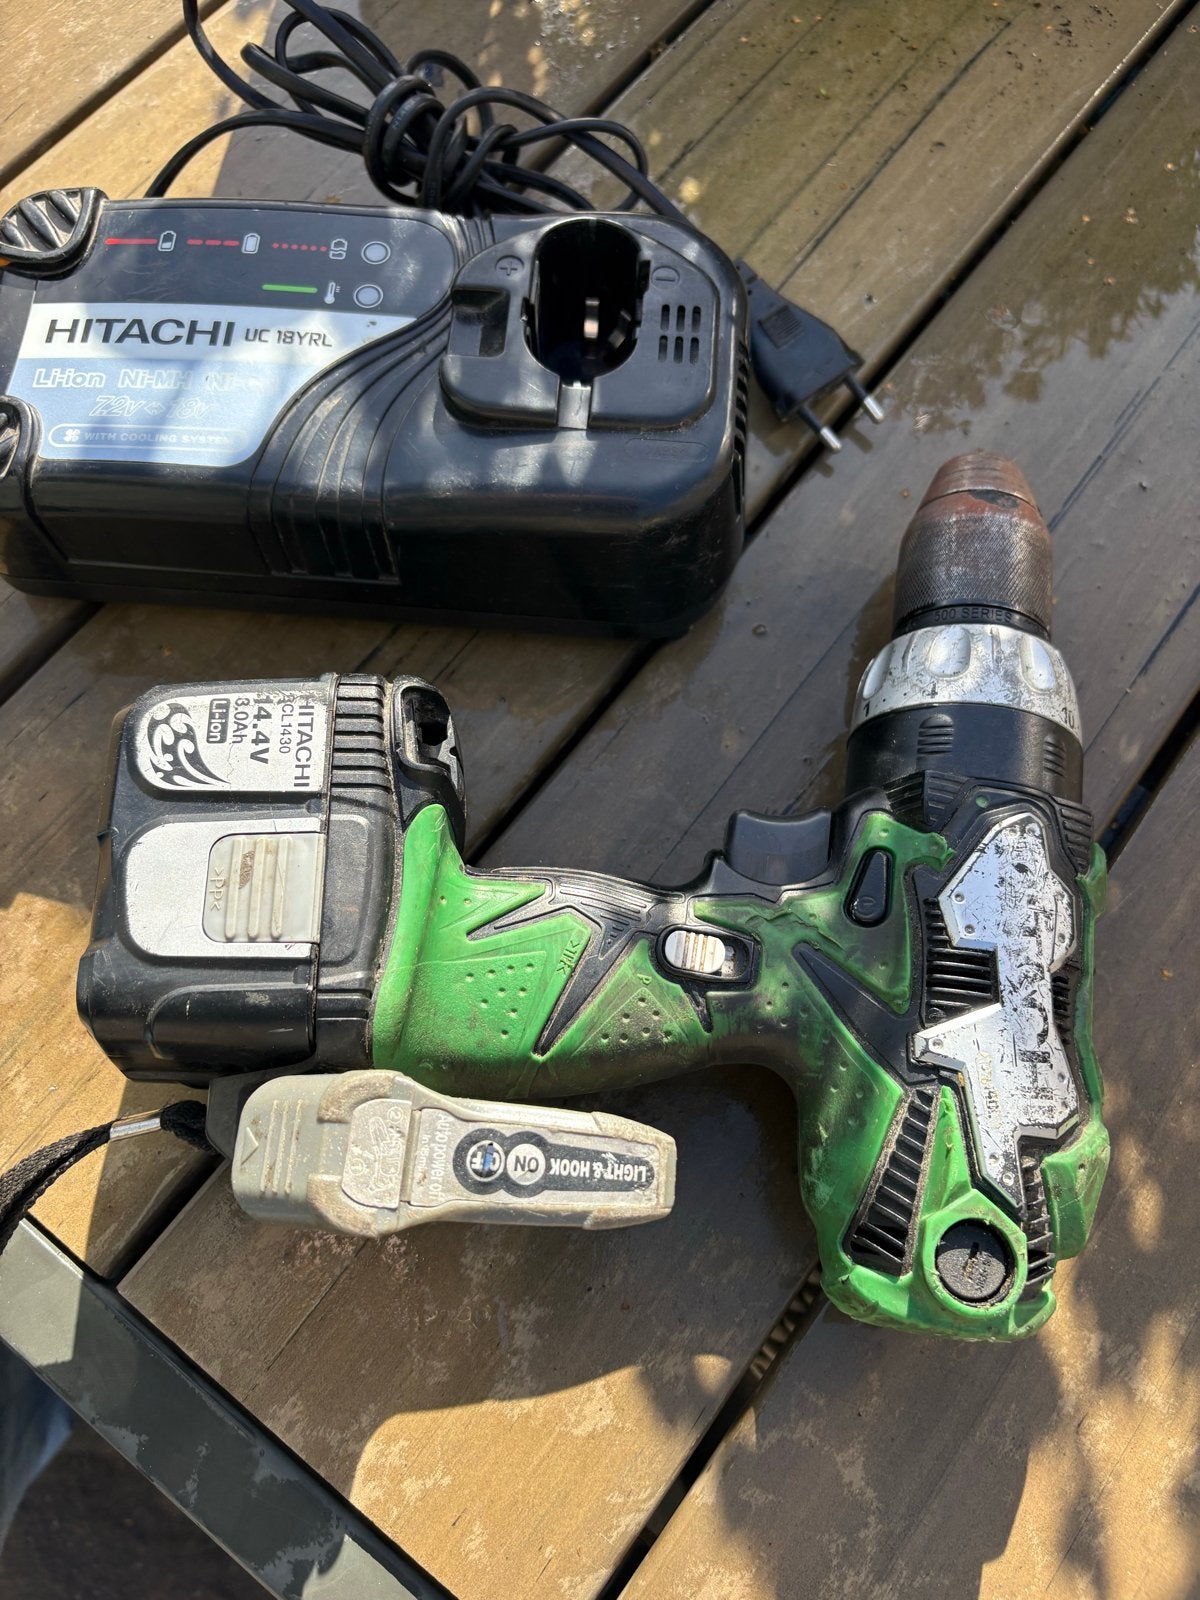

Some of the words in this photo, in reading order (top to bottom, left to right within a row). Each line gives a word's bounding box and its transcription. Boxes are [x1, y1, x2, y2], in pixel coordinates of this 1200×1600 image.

[45, 318, 236, 347] HITACHI
[244, 328, 271, 343] UC
[276, 330, 333, 348] 18YRL
[32, 368, 106, 388] Li-ion
[118, 369, 193, 389] Ni-MH
[84, 431, 117, 441] WITH
[120, 432, 177, 443] COOLING
[934, 608, 957, 622] 500
[961, 607, 1013, 623] SERIES
[208, 700, 227, 743] Li-ion
[231, 697, 250, 744] 3.0Ah
[250, 695, 273, 764] 14.4V
[430, 1143, 448, 1183] power
[471, 1153, 501, 1174] OF
[514, 1155, 540, 1172] ON
[550, 1157, 591, 1177] HOOK
[606, 1163, 648, 1183] LIGHT
